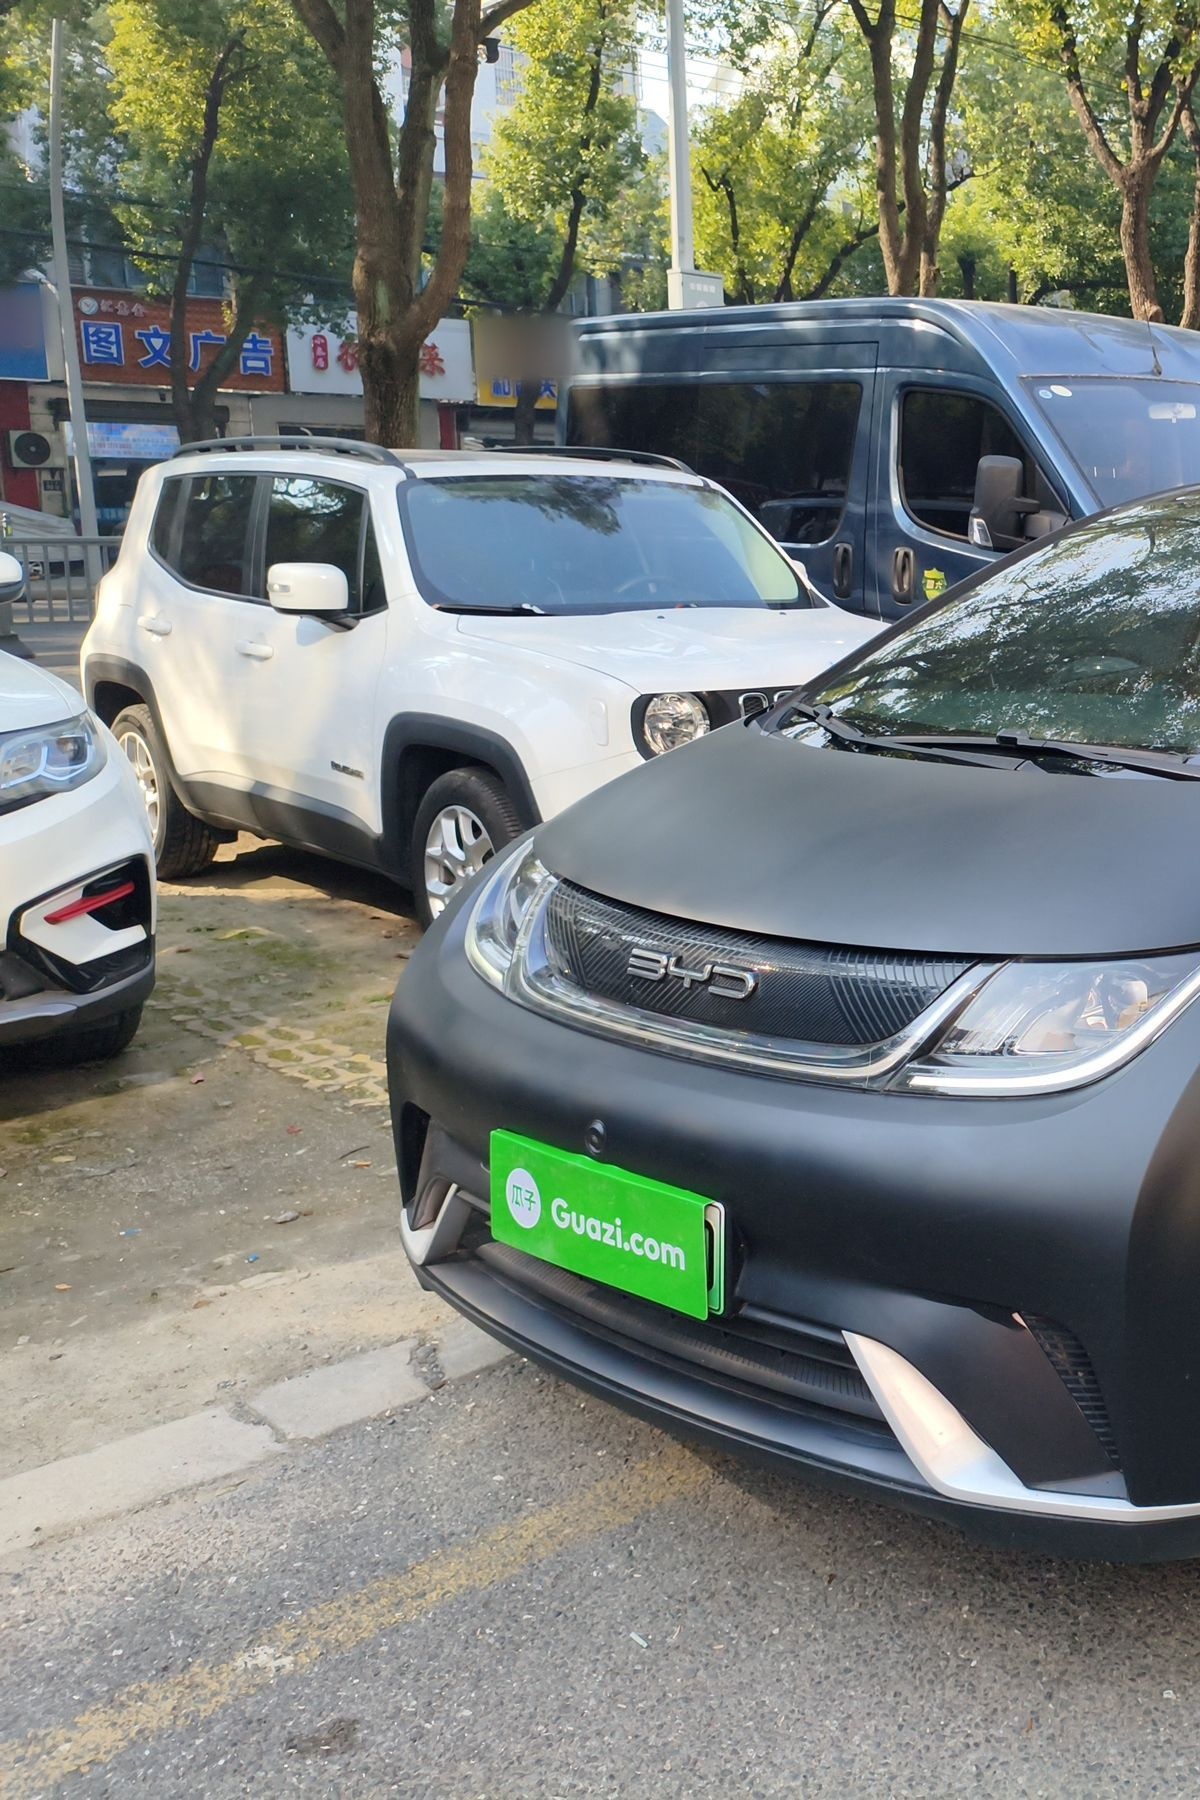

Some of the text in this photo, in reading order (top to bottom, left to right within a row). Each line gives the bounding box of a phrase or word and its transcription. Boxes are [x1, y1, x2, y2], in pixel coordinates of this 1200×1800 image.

[81, 319, 274, 377] 图文广告
[627, 948, 758, 1000] BYD
[512, 1184, 537, 1212] 瓜子
[551, 1197, 687, 1272] Guazi.com
